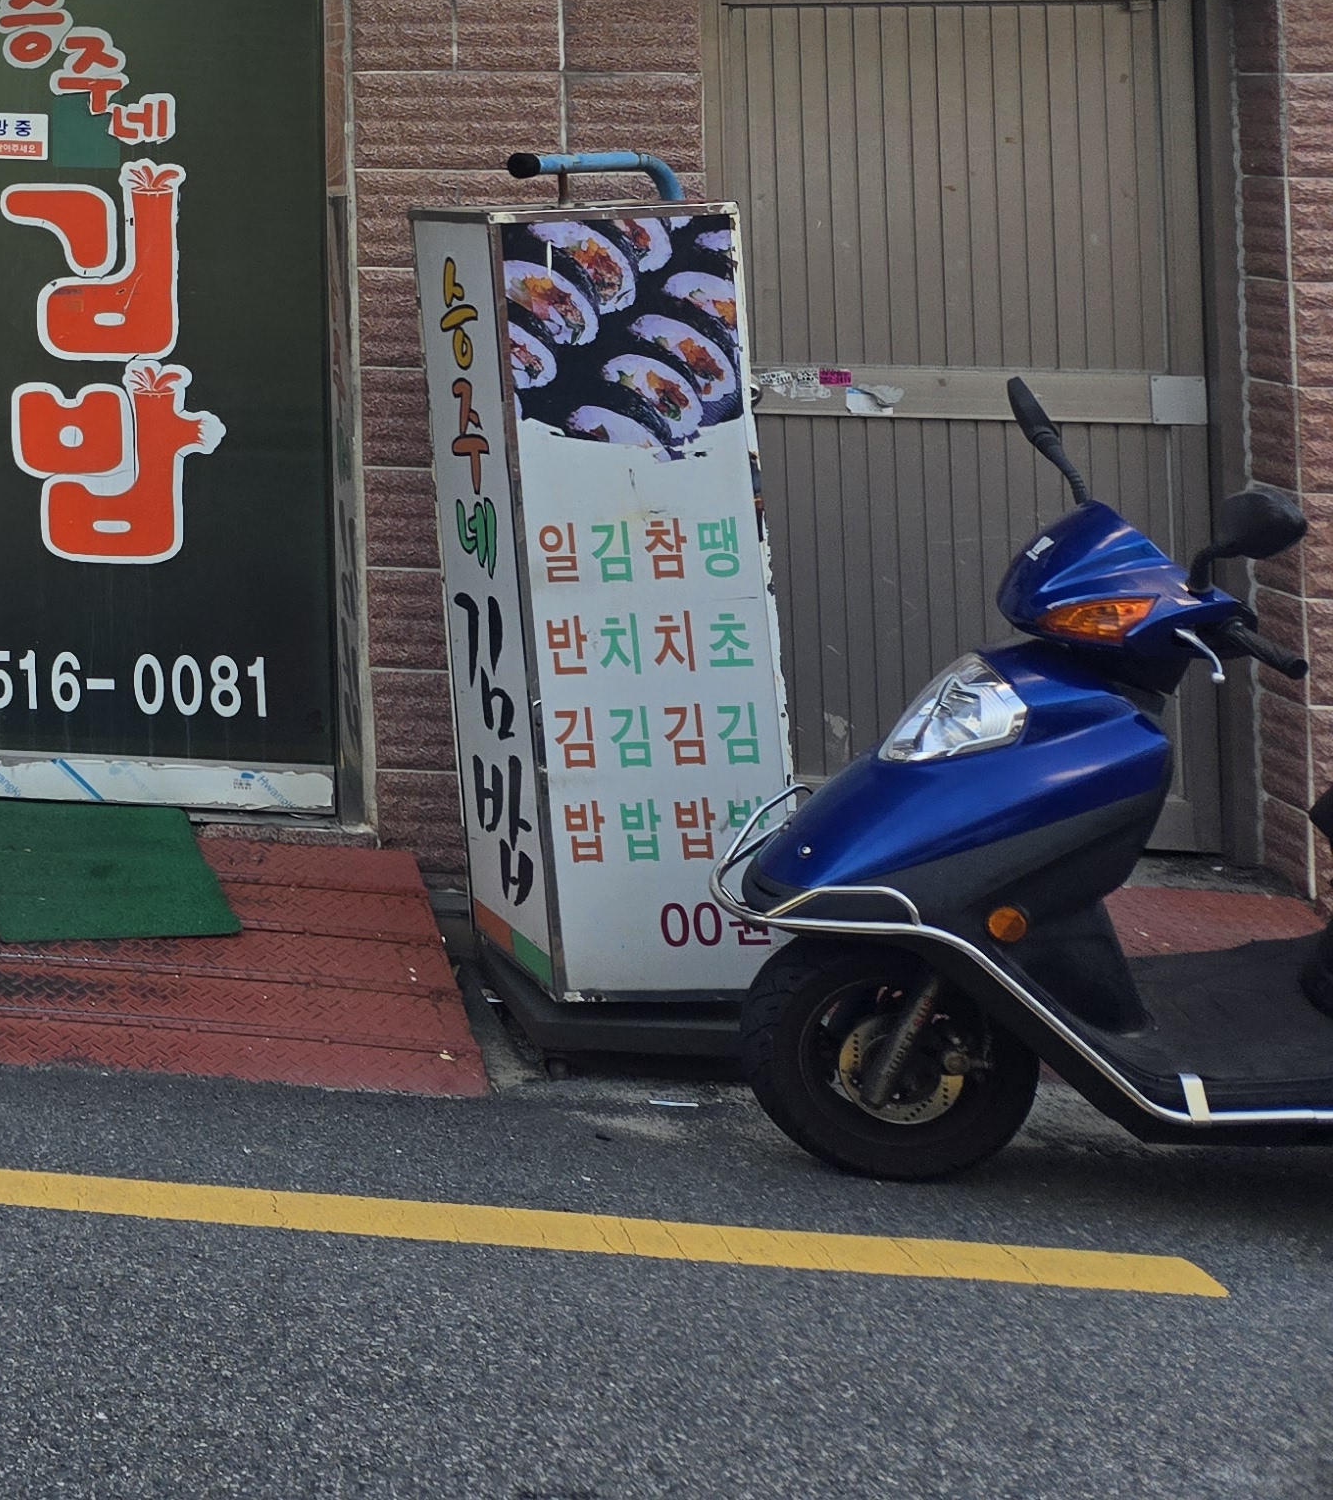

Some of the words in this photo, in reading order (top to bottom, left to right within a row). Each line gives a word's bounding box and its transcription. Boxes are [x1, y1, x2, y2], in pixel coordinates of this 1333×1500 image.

[0, 158, 226, 565] 김밥
[440, 255, 498, 579] 승주네
[454, 591, 533, 907] 김밥
